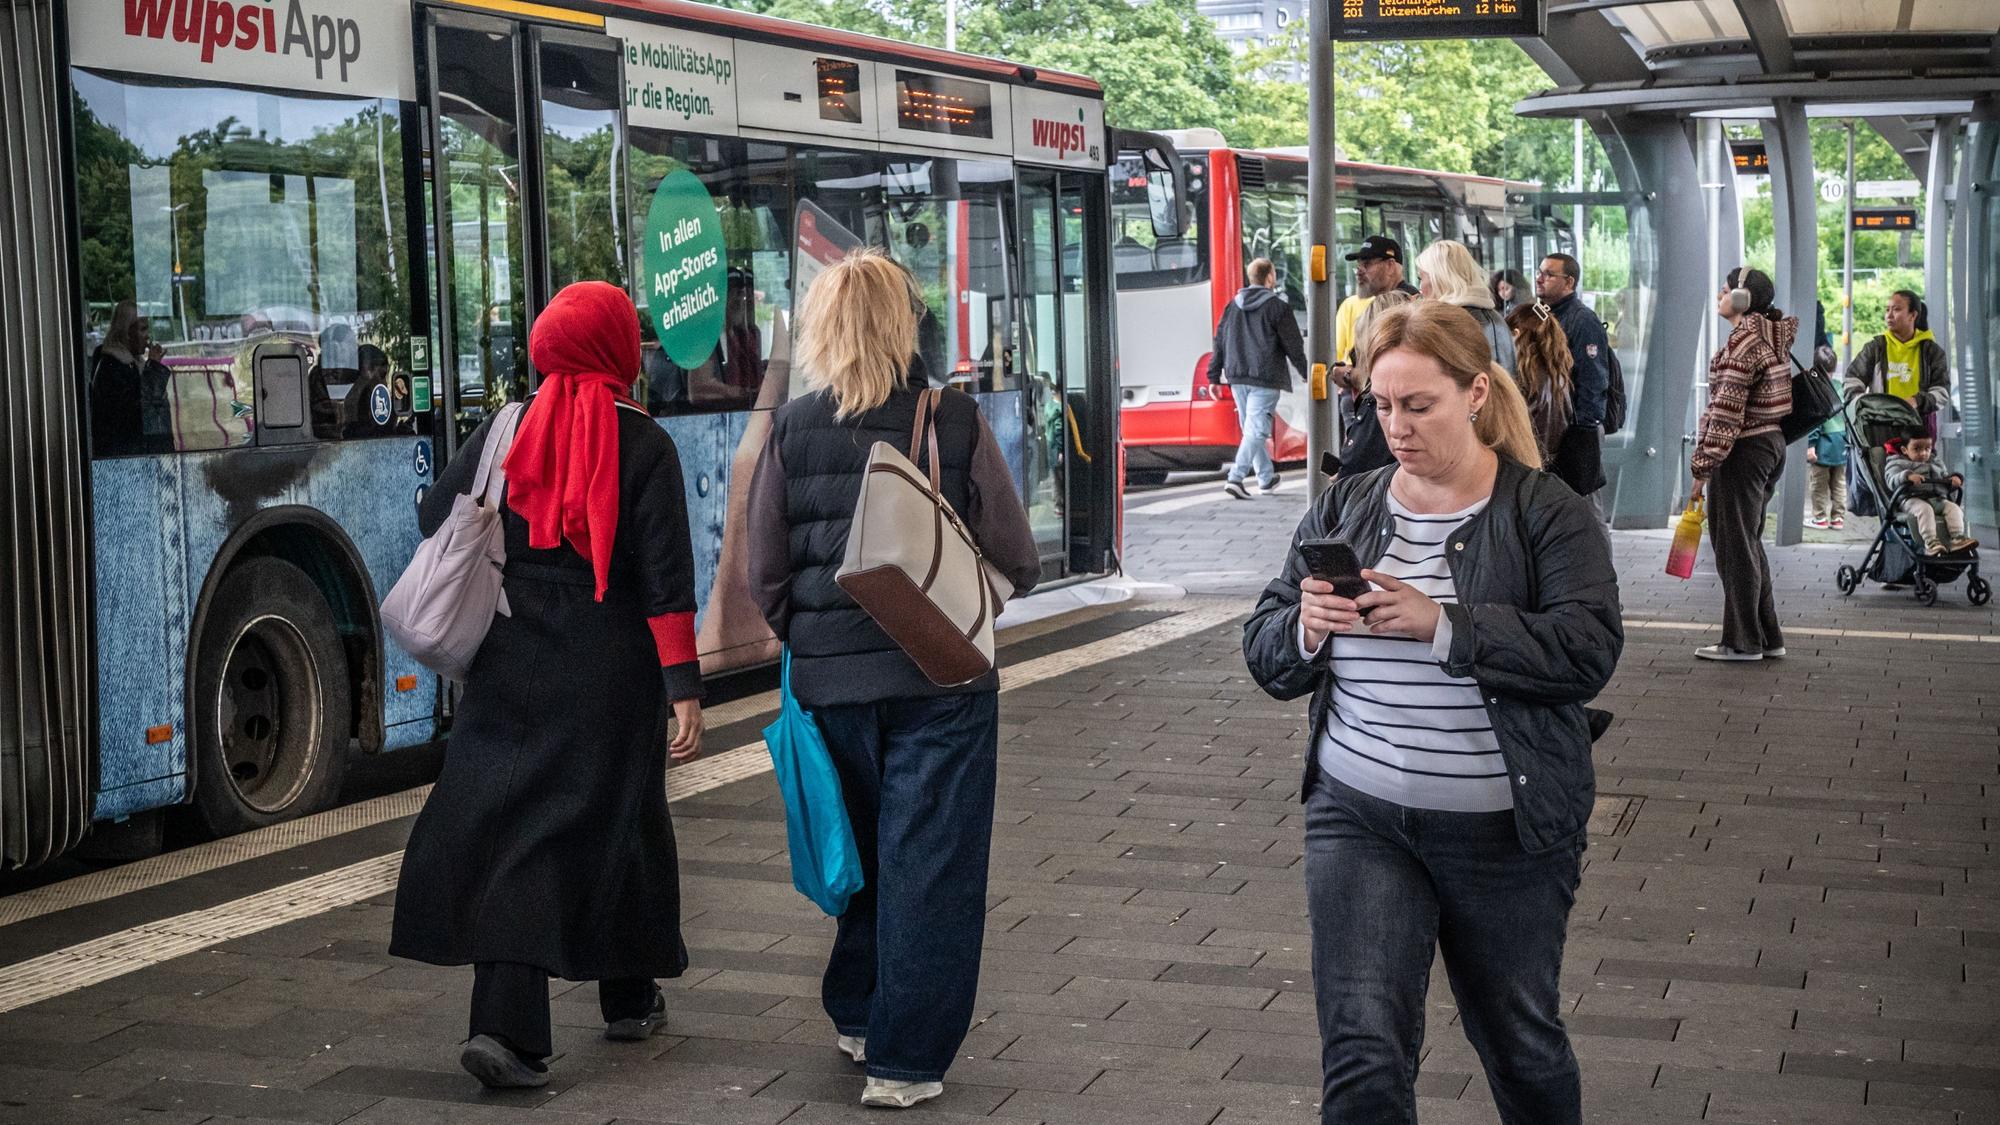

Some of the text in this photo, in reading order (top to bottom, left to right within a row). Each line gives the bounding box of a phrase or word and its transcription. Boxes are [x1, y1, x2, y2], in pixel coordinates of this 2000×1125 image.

[1343, 3, 1517, 18] 201 Lützenkirchen 12 Min
[624, 37, 732, 85] ie MobilitätsApp
[642, 82, 662, 110] die
[665, 86, 714, 121] Region.
[1032, 107, 1086, 160] wupsi
[1824, 183, 1841, 198] 10
[660, 217, 702, 253] In allen
[655, 246, 718, 298] App-Stores
[662, 282, 719, 330] erhältlich.
